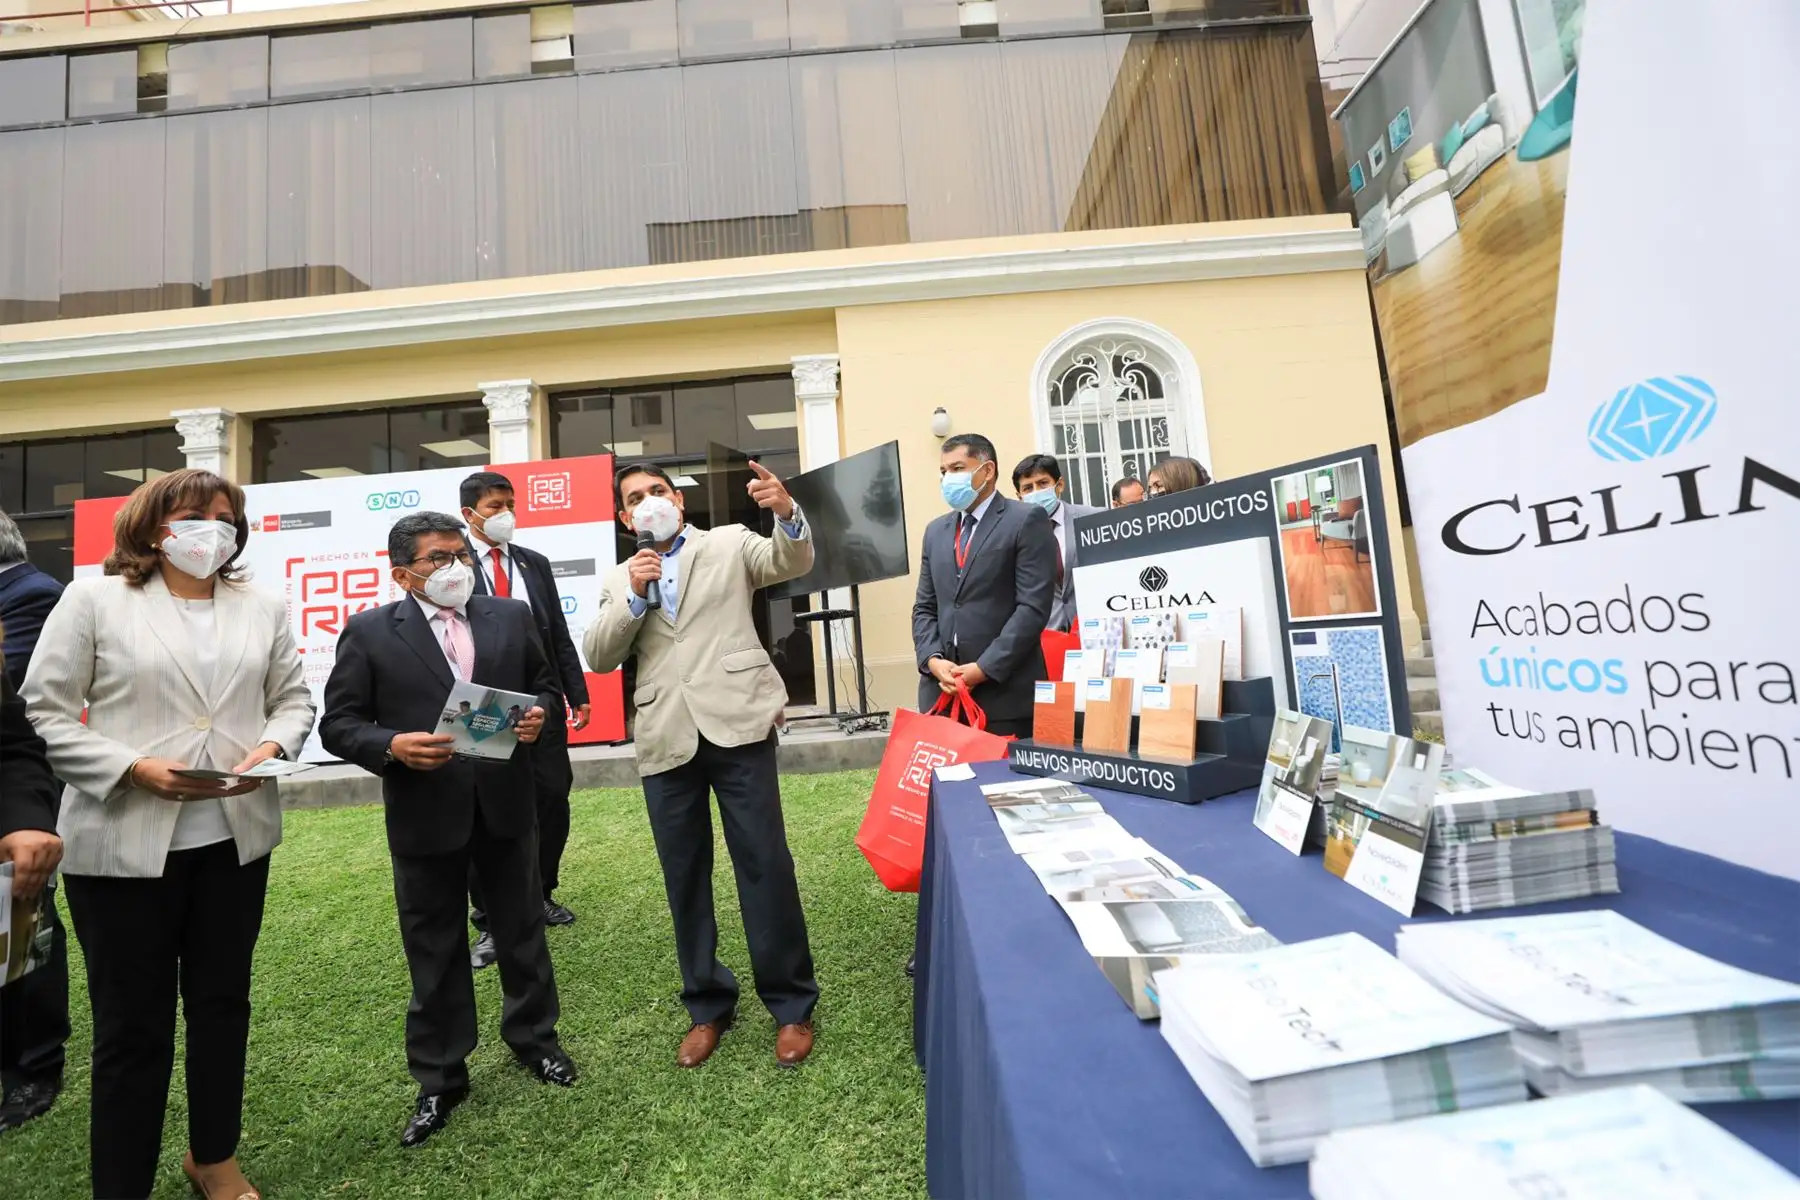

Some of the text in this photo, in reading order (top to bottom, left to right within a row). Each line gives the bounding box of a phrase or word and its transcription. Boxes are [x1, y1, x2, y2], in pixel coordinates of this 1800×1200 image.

[369, 493, 416, 508] SNI
[1080, 490, 1269, 547] NUEVOS PRODUCTOS
[1441, 456, 1800, 556] CELI
[311, 551, 369, 563] HECHO EN
[1105, 591, 1217, 612] CELIMA
[1470, 583, 1711, 639] Acabados
[1479, 646, 1798, 710] únicos para
[1486, 702, 1800, 779] tus ambien
[1015, 749, 1176, 792] NUEVOS PRODUCTOS
